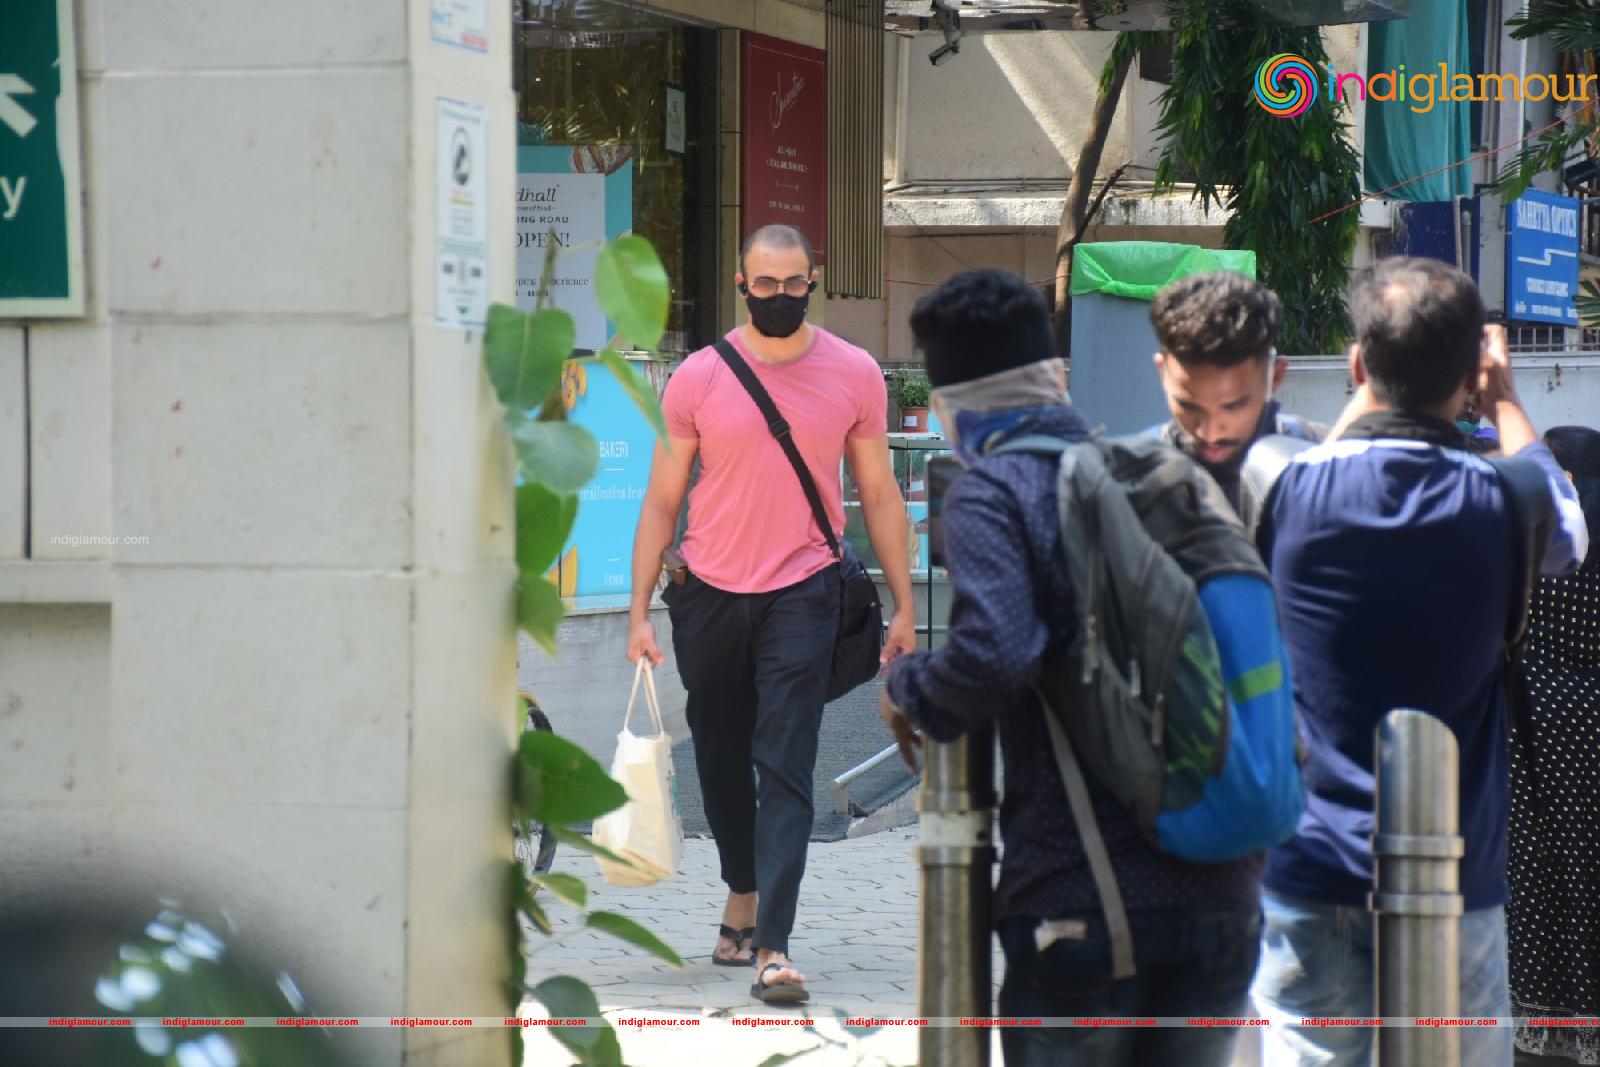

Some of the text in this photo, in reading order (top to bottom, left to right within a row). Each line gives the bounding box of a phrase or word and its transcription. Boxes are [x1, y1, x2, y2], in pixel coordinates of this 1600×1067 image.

[516, 187, 556, 202] dhall
[516, 215, 569, 223] ING ROAD
[599, 440, 629, 458] BAKERY
